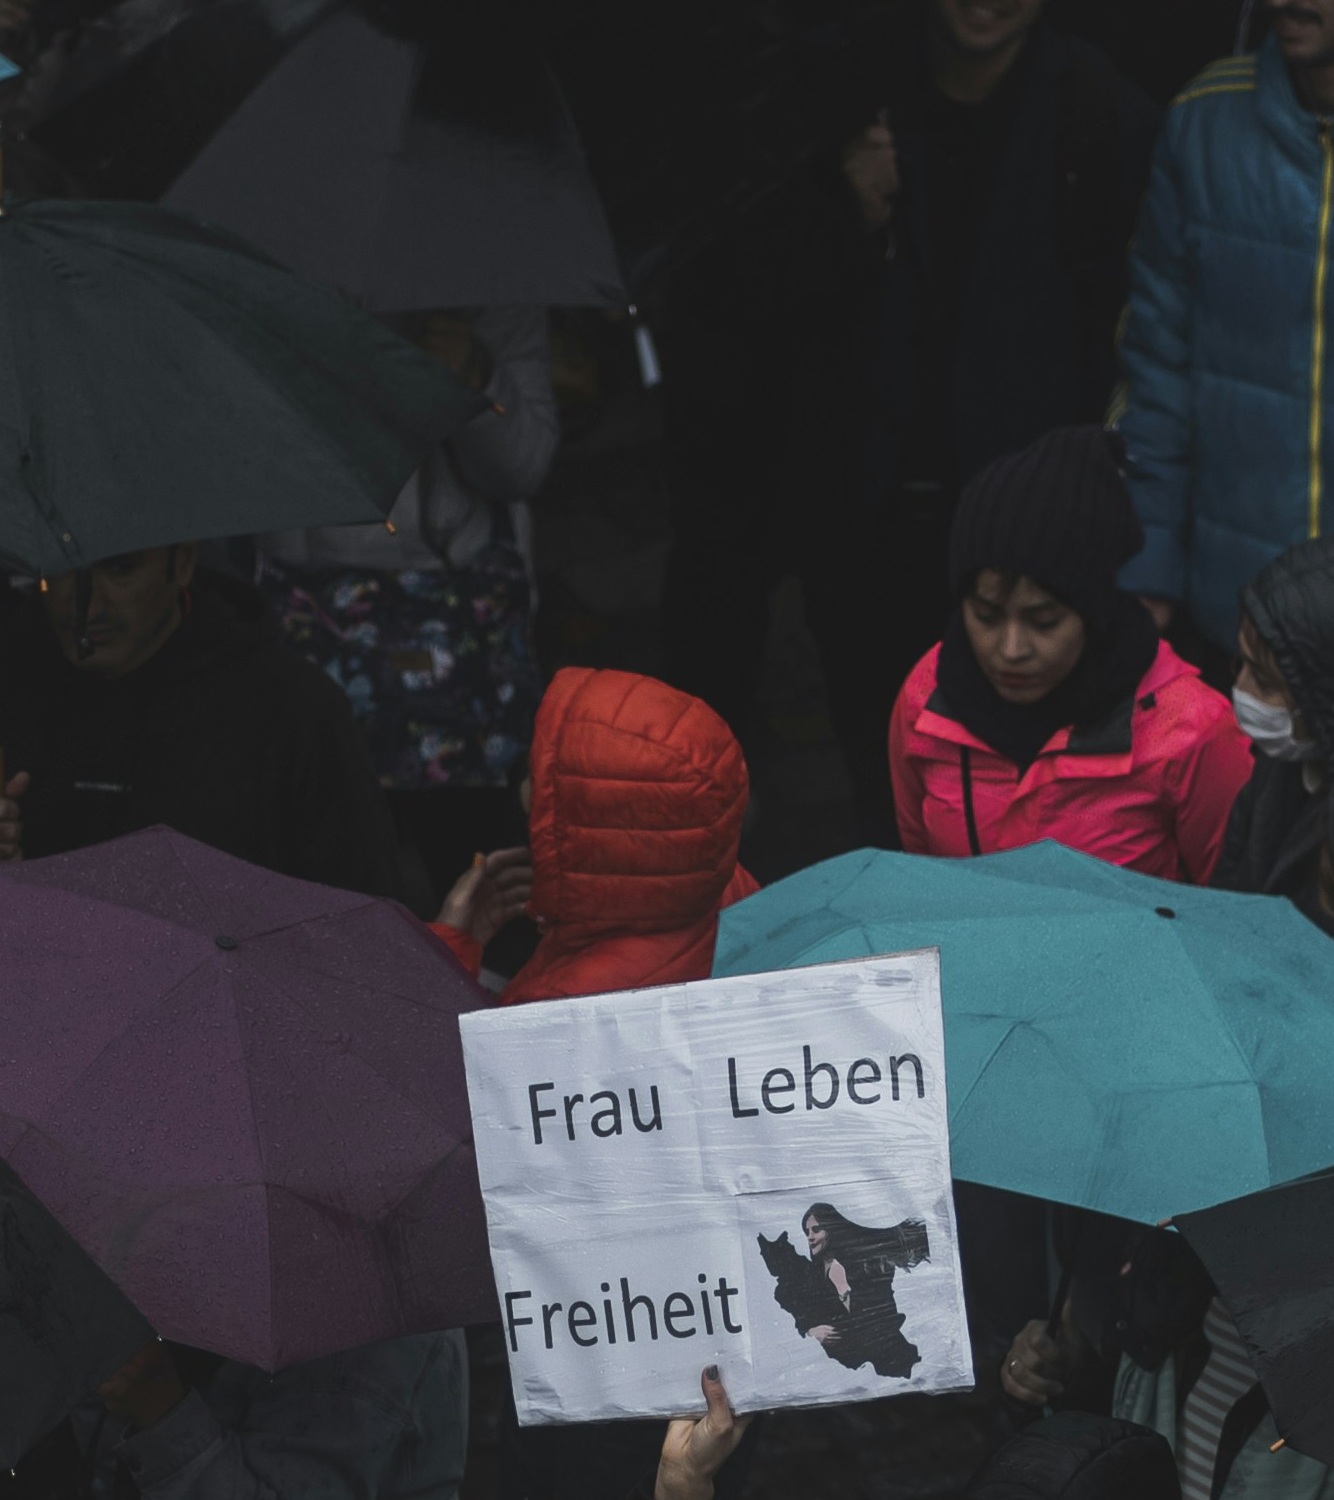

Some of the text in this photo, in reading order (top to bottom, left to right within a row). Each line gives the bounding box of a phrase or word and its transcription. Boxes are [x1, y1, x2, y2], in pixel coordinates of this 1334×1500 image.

[527, 1043, 926, 1146] Frau Leben
[504, 1272, 743, 1353] Freiheit
